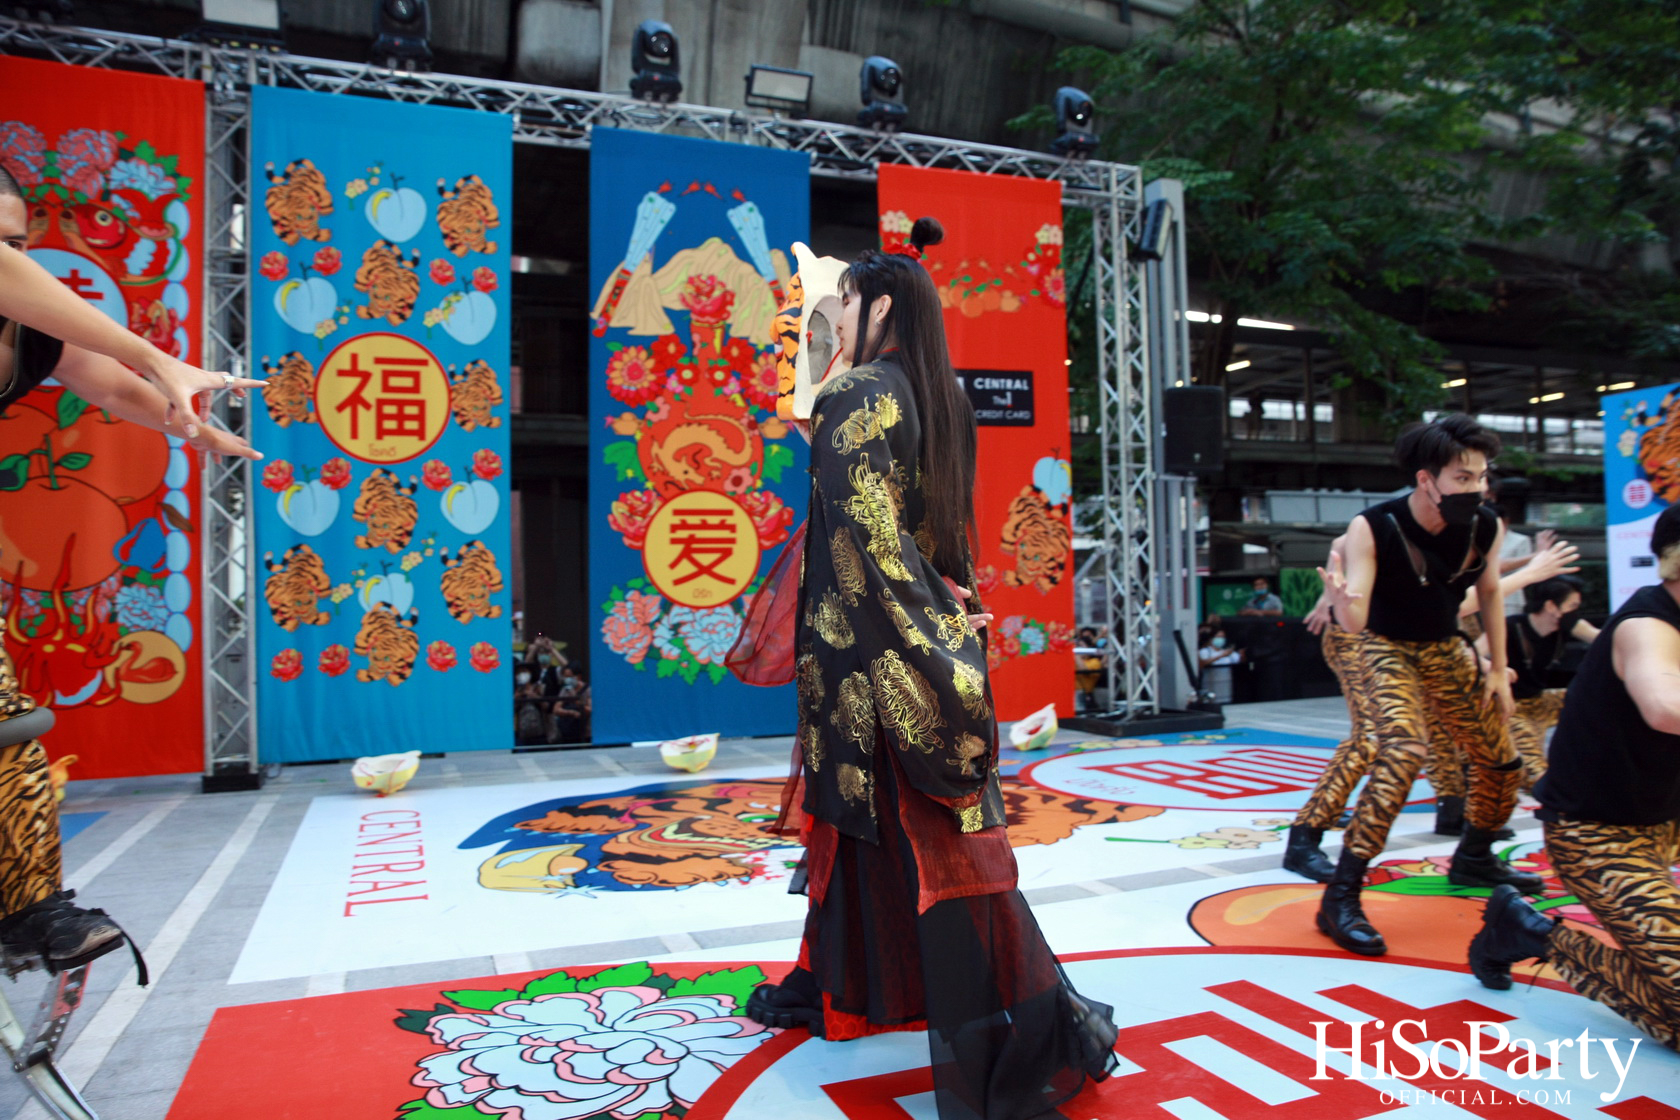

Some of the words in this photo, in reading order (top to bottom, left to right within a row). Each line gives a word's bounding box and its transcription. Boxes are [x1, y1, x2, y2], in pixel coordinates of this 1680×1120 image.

[335, 353, 429, 442] 福
[973, 377, 1029, 391] CENTRAL
[1005, 410, 1031, 420] CARD
[668, 508, 737, 587] 爱
[344, 809, 429, 917] CENTRAL
